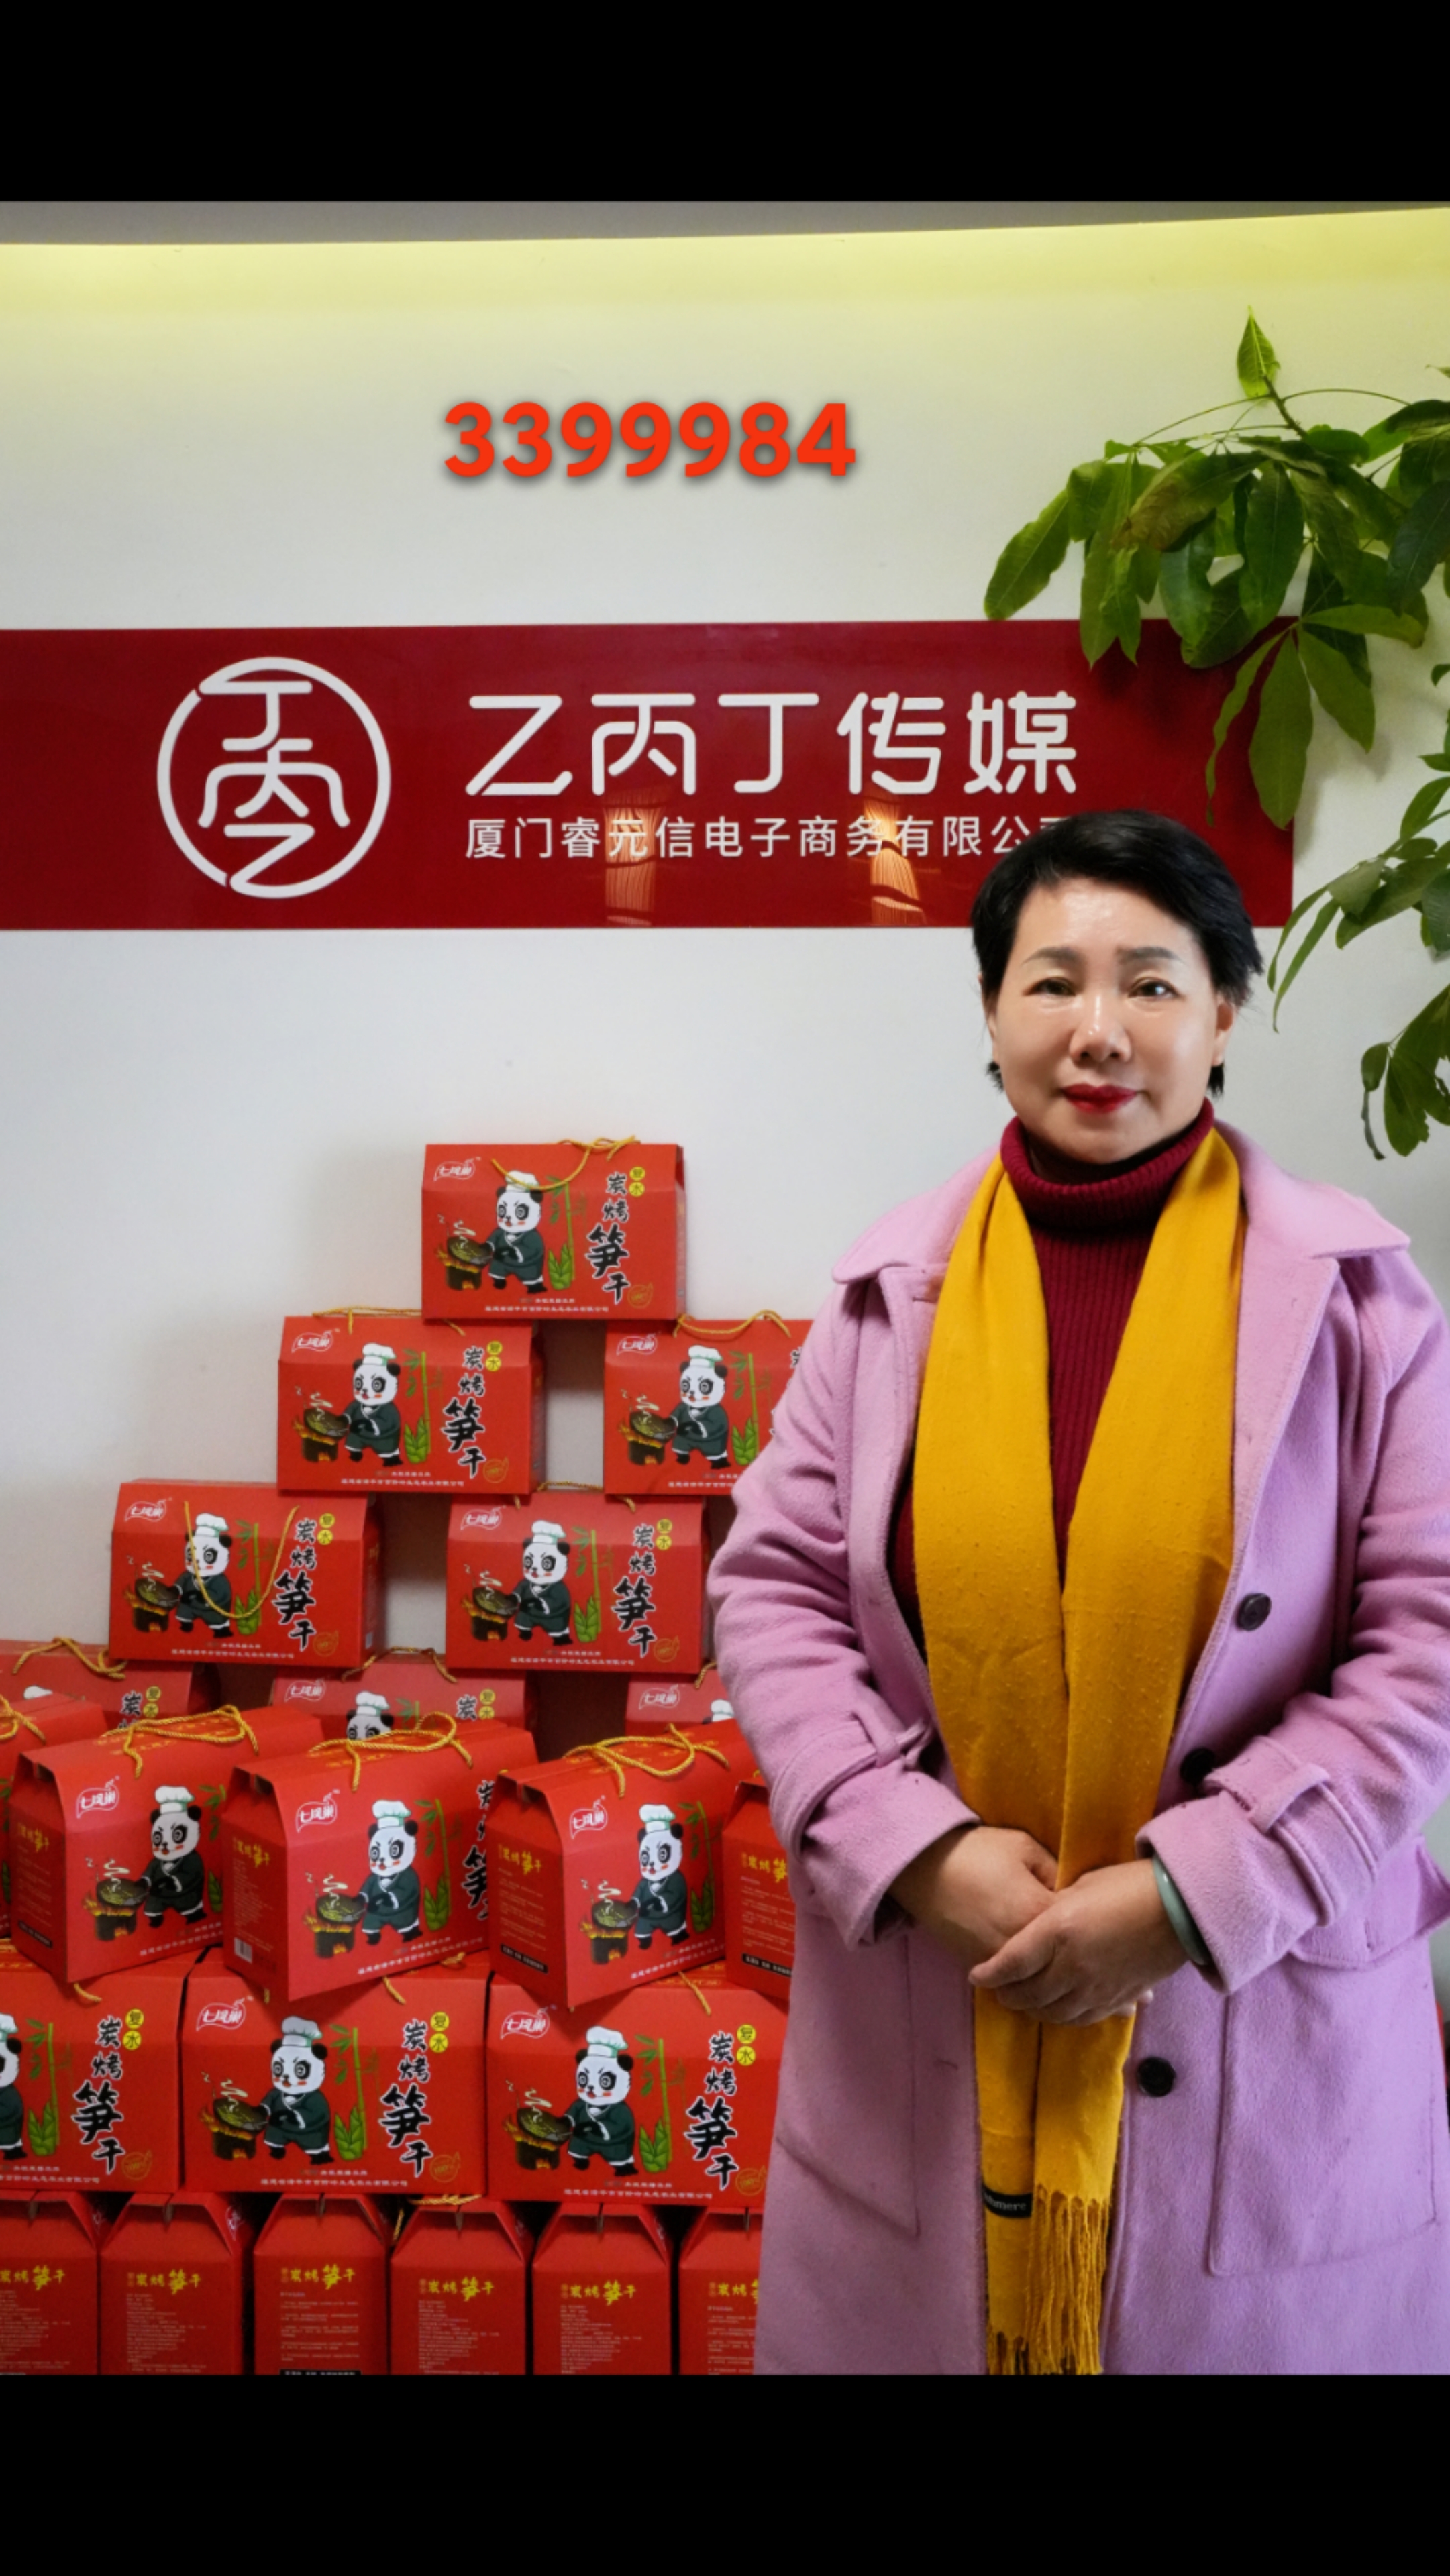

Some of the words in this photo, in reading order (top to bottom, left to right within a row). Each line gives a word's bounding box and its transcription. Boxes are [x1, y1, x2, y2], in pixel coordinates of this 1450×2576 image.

[466, 690, 1077, 796] 乙丙丁传媒
[465, 814, 1070, 861] 厦门睿元信电子商务有限公
[584, 1171, 630, 1305] 炭烤笋干
[441, 1345, 487, 1480] 炭烤笋干
[272, 1517, 317, 1652] 炭烤笋干
[610, 1523, 657, 1658] 炭烤笋干
[72, 2015, 125, 2175] 炭烤笋干
[378, 2018, 434, 2178] 炭烤笋干
[684, 2030, 739, 2191] 炭烤笋干
